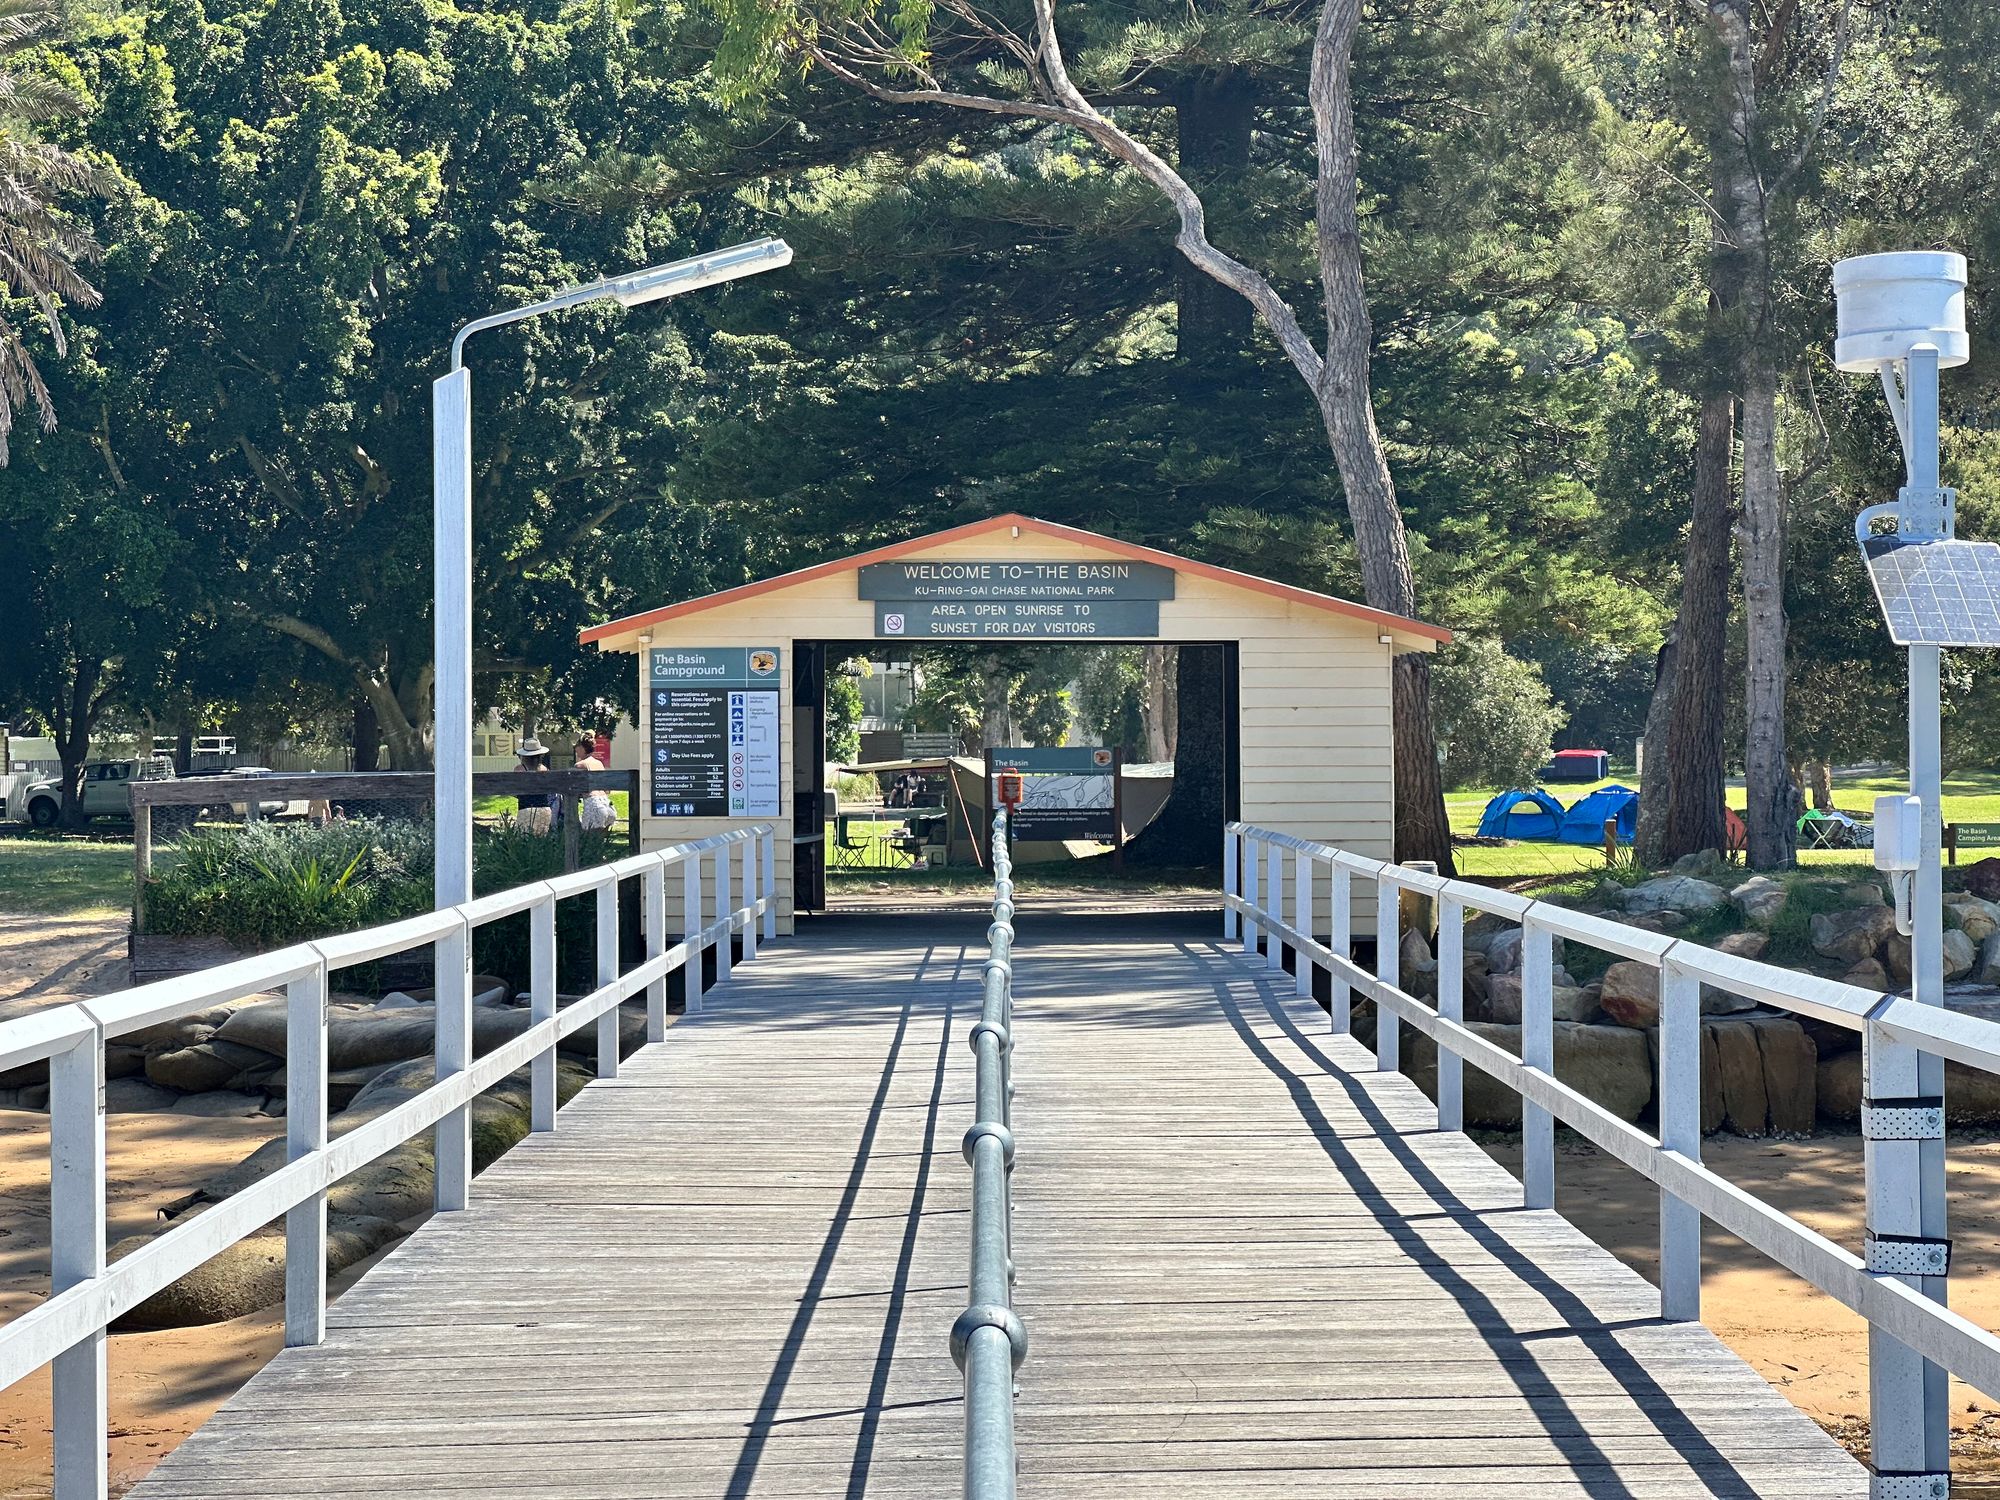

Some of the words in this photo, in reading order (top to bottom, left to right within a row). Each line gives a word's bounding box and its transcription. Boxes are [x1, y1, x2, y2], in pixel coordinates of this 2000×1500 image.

[904, 565, 991, 579] WELCOME
[1078, 565, 1129, 579] BASIN
[915, 586, 988, 595] KU-RING-GAI
[991, 586, 1027, 595] CHASE
[1030, 586, 1084, 595] NATIONAL
[1087, 586, 1115, 595] PARK
[931, 605, 966, 615] AREA
[974, 605, 1006, 615] OPEN
[1015, 605, 1064, 616] SUNRISE
[1073, 605, 1090, 615] TO
[931, 623, 977, 633] SUNSET
[984, 623, 1009, 633] FOR
[1013, 623, 1037, 633] DAY
[1044, 623, 1096, 633] VISITORS
[654, 654, 675, 664] The
[677, 654, 706, 664] Basin
[655, 665, 725, 678] Campground
[1084, 832, 1114, 840] Welcome
